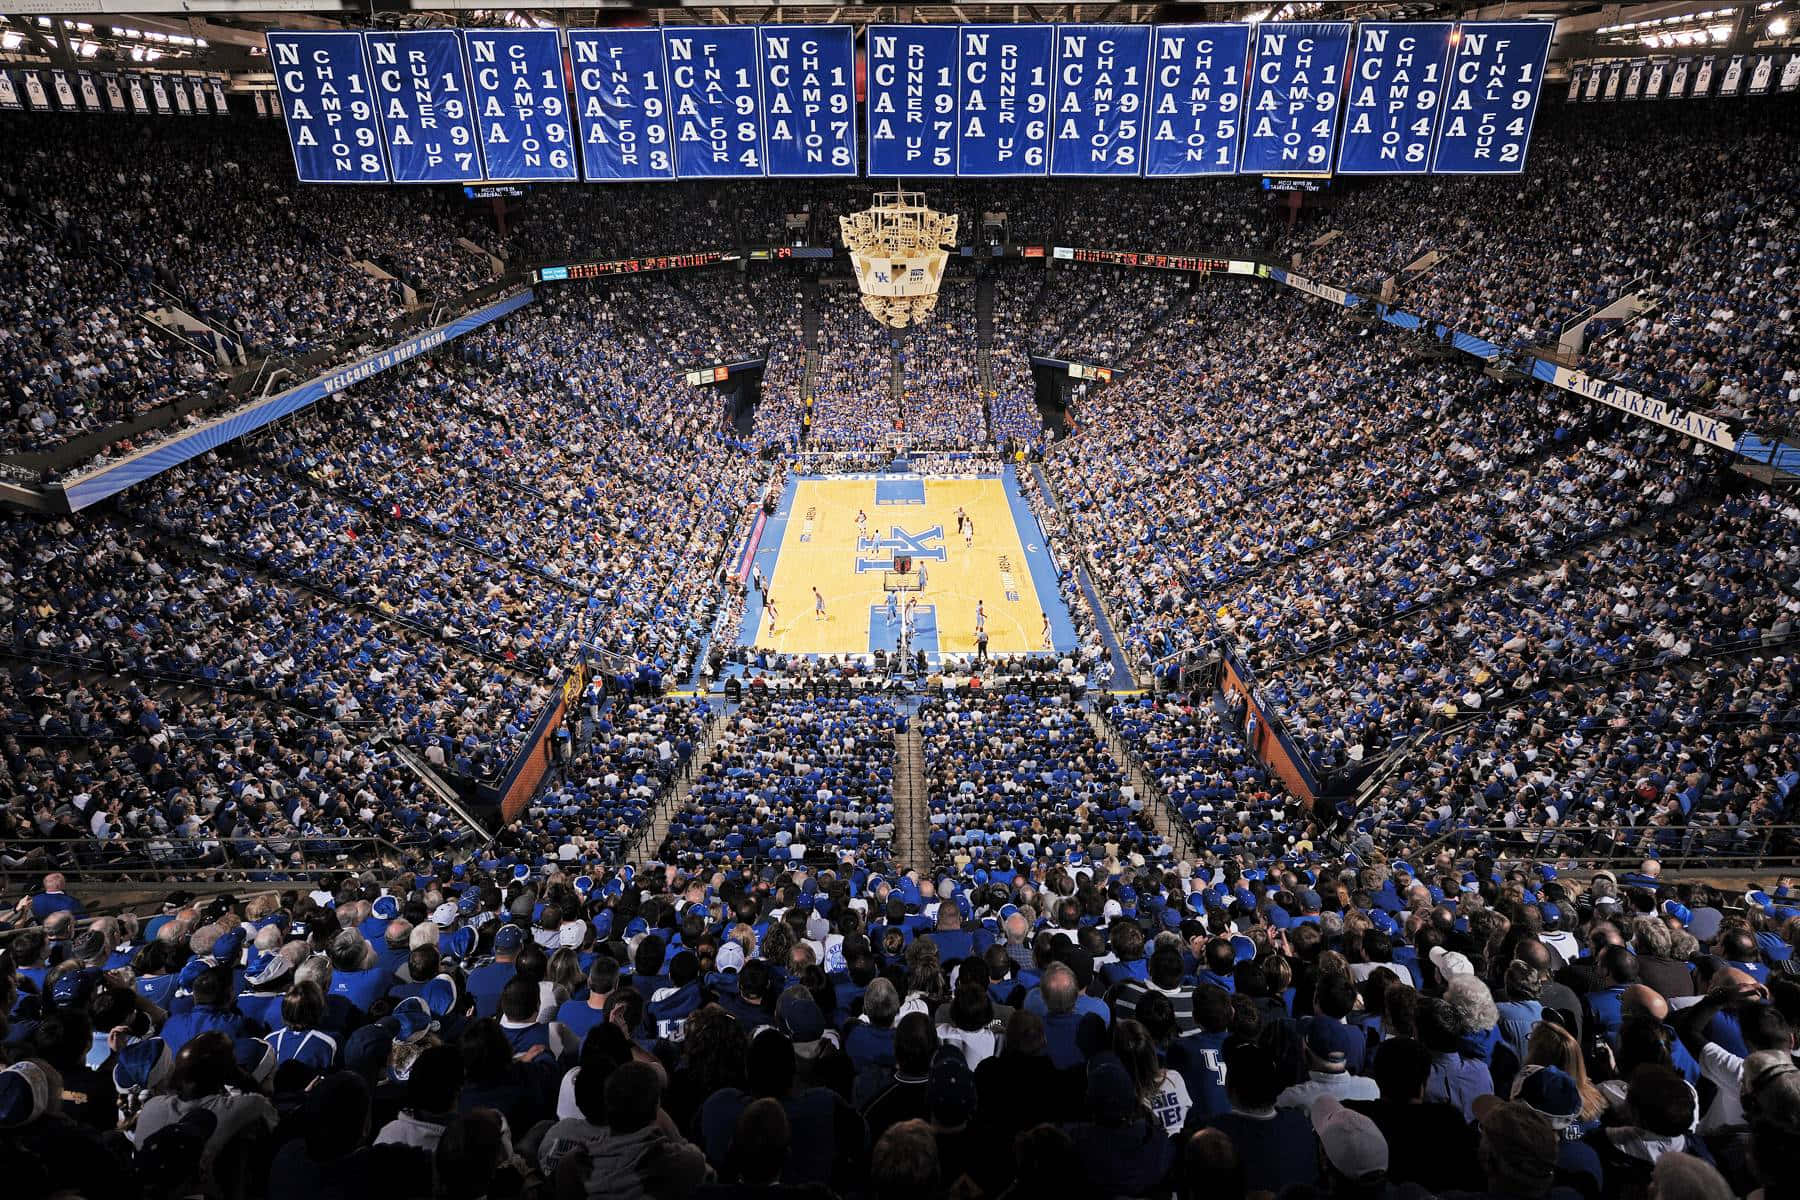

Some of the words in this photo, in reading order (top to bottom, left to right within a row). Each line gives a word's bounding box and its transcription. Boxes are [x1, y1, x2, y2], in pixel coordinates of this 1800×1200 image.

[275, 43, 319, 146] NCAA
[313, 50, 352, 171] CHAMPION
[373, 42, 414, 145] NCAA
[408, 50, 438, 129] RUNNER
[425, 143, 443, 168] UP
[472, 40, 510, 144] NCAA
[508, 44, 541, 167] CHAMPION
[541, 69, 569, 169] 1996
[575, 40, 609, 144] NCAA
[609, 47, 632, 107] FINAL
[669, 38, 702, 142] NCAA
[703, 44, 724, 104] FINAL
[735, 68, 759, 167] 1984
[766, 37, 793, 140] NCAA
[801, 40, 823, 163] CHAMPION
[829, 67, 851, 167] 1978
[873, 36, 898, 140] NCAA
[906, 44, 925, 123] RUNNER
[933, 67, 954, 166] 1975
[964, 33, 990, 137] NCAA
[999, 44, 1018, 124] RUNNER
[1024, 66, 1046, 166] 1966
[1058, 36, 1087, 139] NCAA
[1091, 40, 1115, 162] CHAMPION
[1113, 66, 1139, 166] 1958
[1154, 37, 1186, 141] NCAA
[1186, 39, 1214, 162] CHAMPION
[1215, 65, 1238, 165] 1951
[1252, 34, 1287, 137] NCAA
[1282, 38, 1315, 160] CHAMPION
[1307, 64, 1336, 164] 1949
[1350, 29, 1389, 134] NCAA
[1380, 37, 1416, 159] CHAMPION
[1405, 63, 1438, 163] 1948
[1445, 33, 1488, 137] NCAA
[1486, 40, 1512, 100] FINAL
[1499, 63, 1533, 162] 1942
[347, 74, 381, 173] 1998
[442, 72, 473, 171] 1997
[618, 119, 639, 165] FOUR
[643, 70, 671, 172] 1993
[709, 116, 730, 163] FOUR
[906, 136, 922, 161] UP
[998, 137, 1014, 162] UP
[1474, 112, 1497, 159] FOUR
[323, 361, 377, 393] WELCOME
[379, 355, 391, 369] TO
[393, 343, 418, 361] RUPP
[421, 331, 447, 350] ARENA
[1669, 409, 1721, 441] BANK
